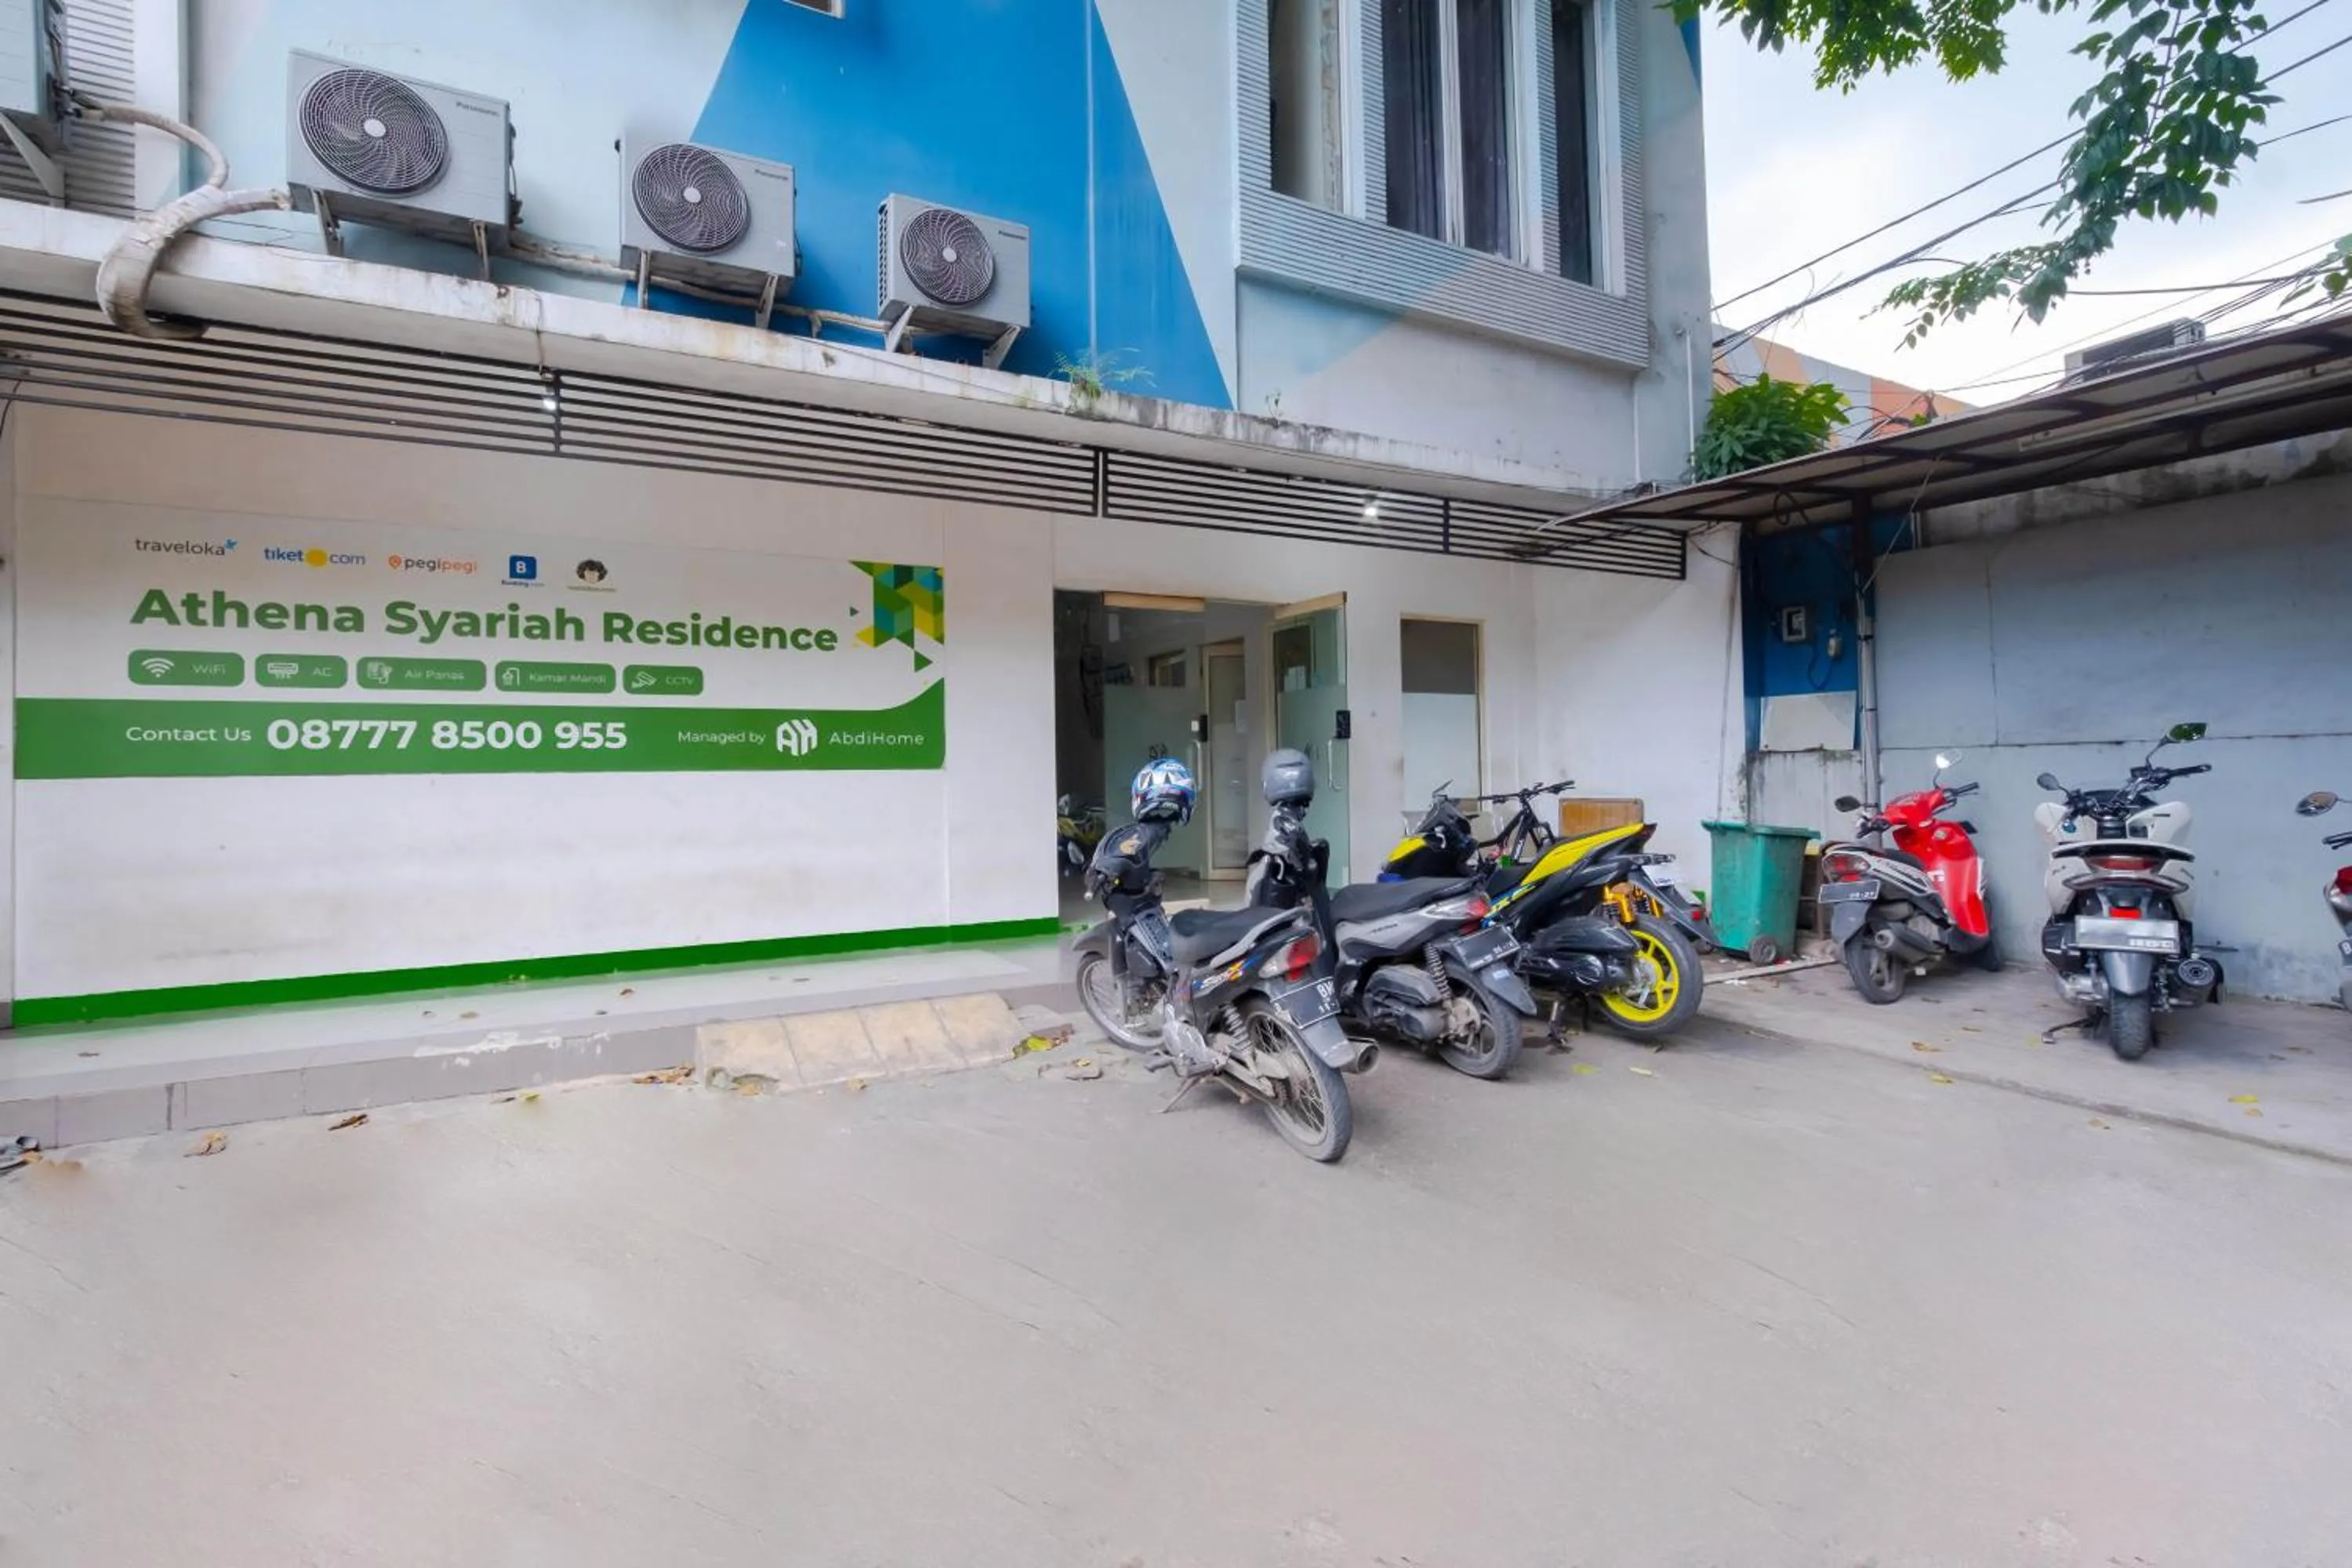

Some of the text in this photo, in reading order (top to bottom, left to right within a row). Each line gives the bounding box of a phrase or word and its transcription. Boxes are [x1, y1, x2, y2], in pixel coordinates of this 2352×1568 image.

[135, 539, 225, 556] traveloka
[404, 556, 477, 574] pegipegi
[129, 589, 838, 652] Athena Syariah Residence
[192, 664, 226, 675] WiFi
[314, 667, 332, 677] AC
[405, 669, 465, 680] Air Panas
[666, 676, 695, 685] CCTV
[125, 719, 627, 750] Contact Us 08777 8500 955
[677, 730, 766, 746] Managed by
[829, 731, 925, 746] AbdiHome
